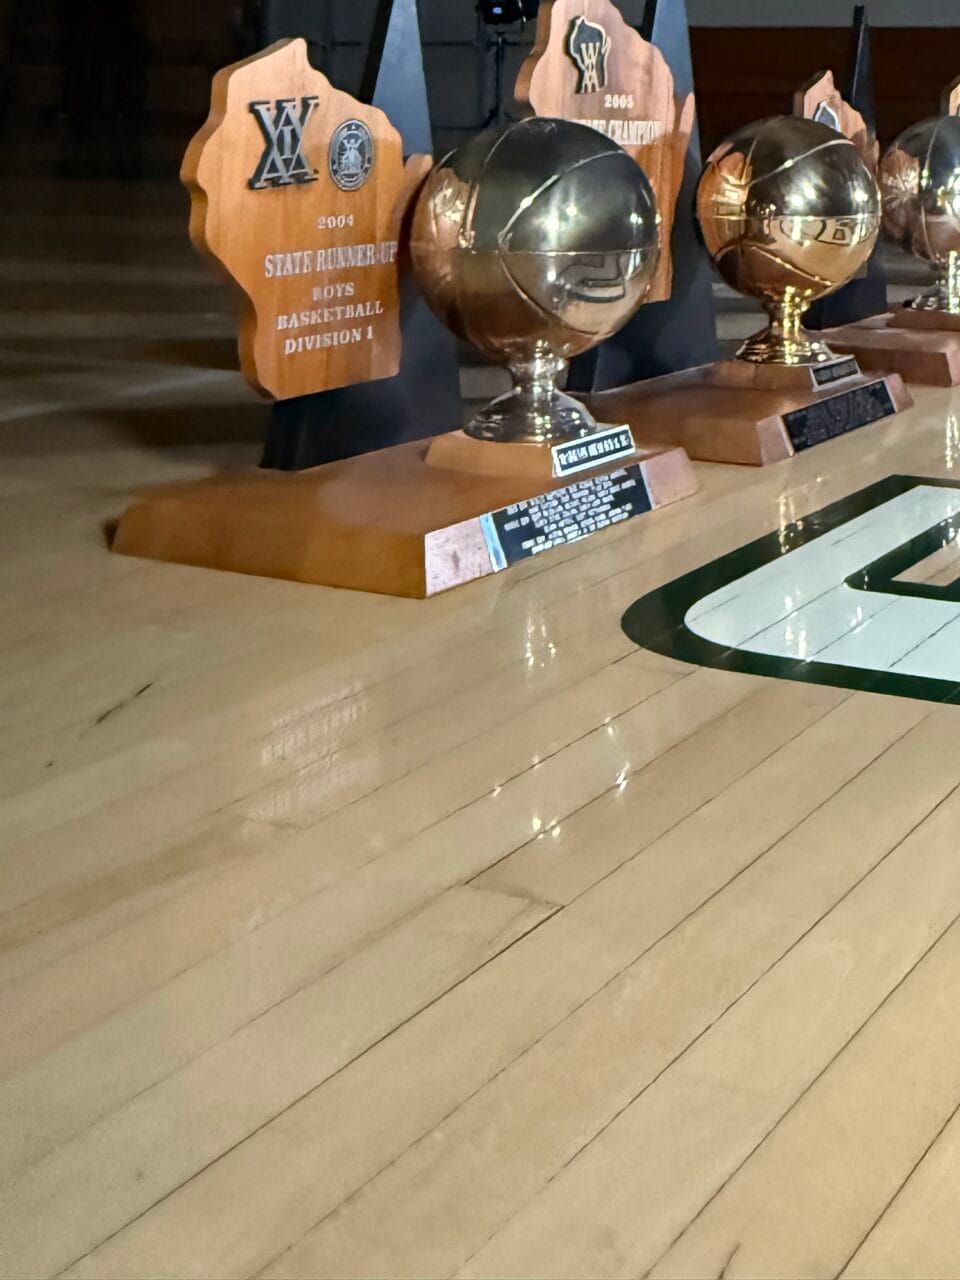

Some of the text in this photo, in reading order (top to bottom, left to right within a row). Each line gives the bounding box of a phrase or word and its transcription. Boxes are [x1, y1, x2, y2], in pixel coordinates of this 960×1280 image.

[317, 213, 355, 229] 2004
[264, 240, 399, 279] STATE RUNNER-UP
[311, 281, 355, 302] BOYS
[275, 300, 384, 331] BASKETBALL
[283, 325, 374, 356] DIVISION 1
